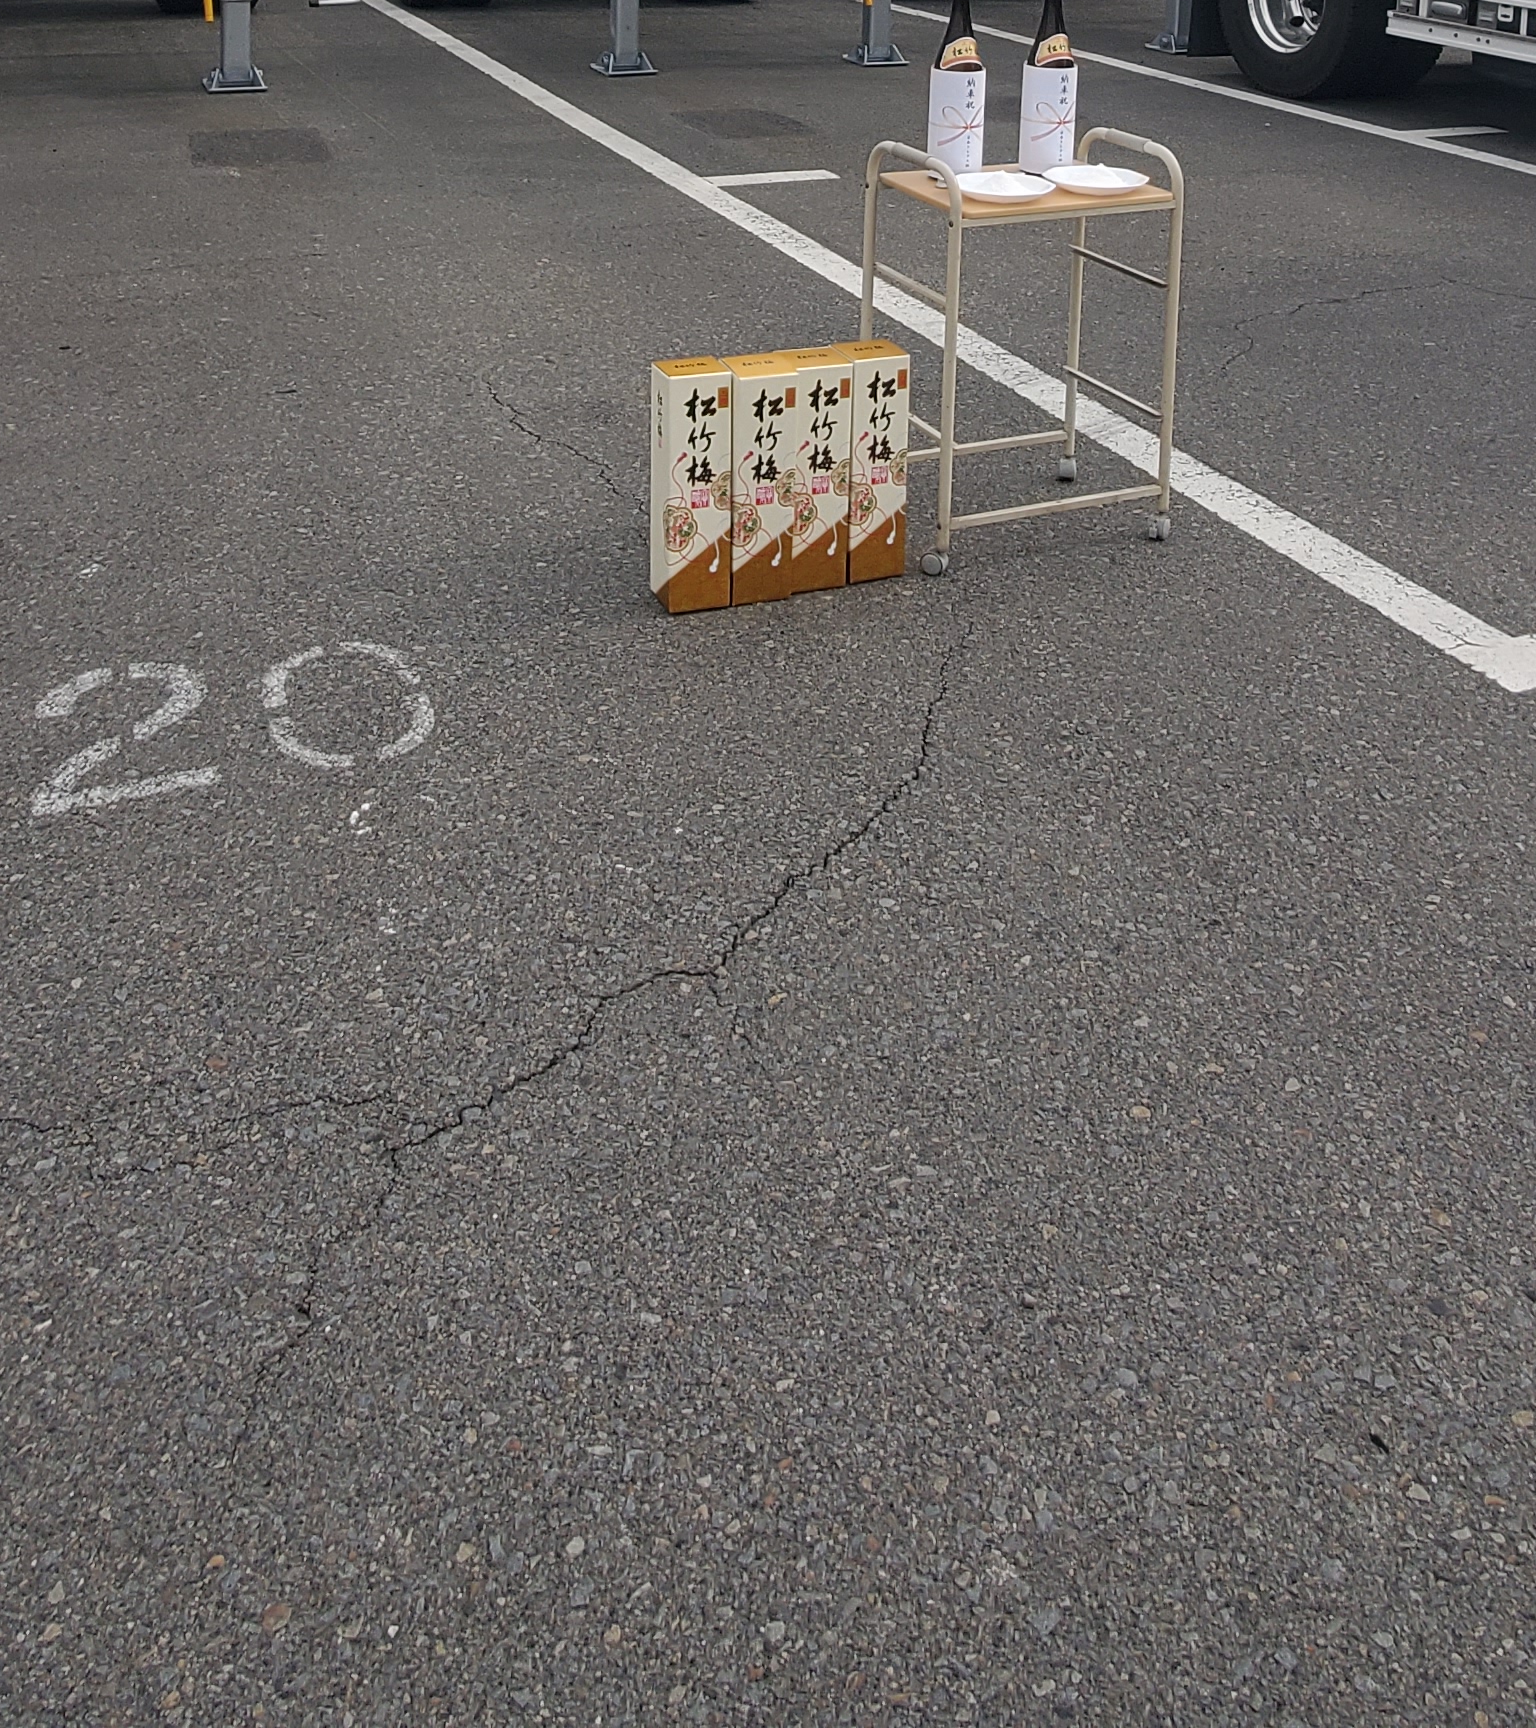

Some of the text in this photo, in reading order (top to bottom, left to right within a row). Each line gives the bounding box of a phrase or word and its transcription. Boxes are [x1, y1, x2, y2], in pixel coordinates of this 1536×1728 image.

[683, 388, 716, 487] 松竹梅
[751, 388, 784, 484] 松竹梅
[808, 379, 839, 473] 松竹梅
[866, 371, 897, 464] 松竹梅
[31, 641, 435, 816] 20
